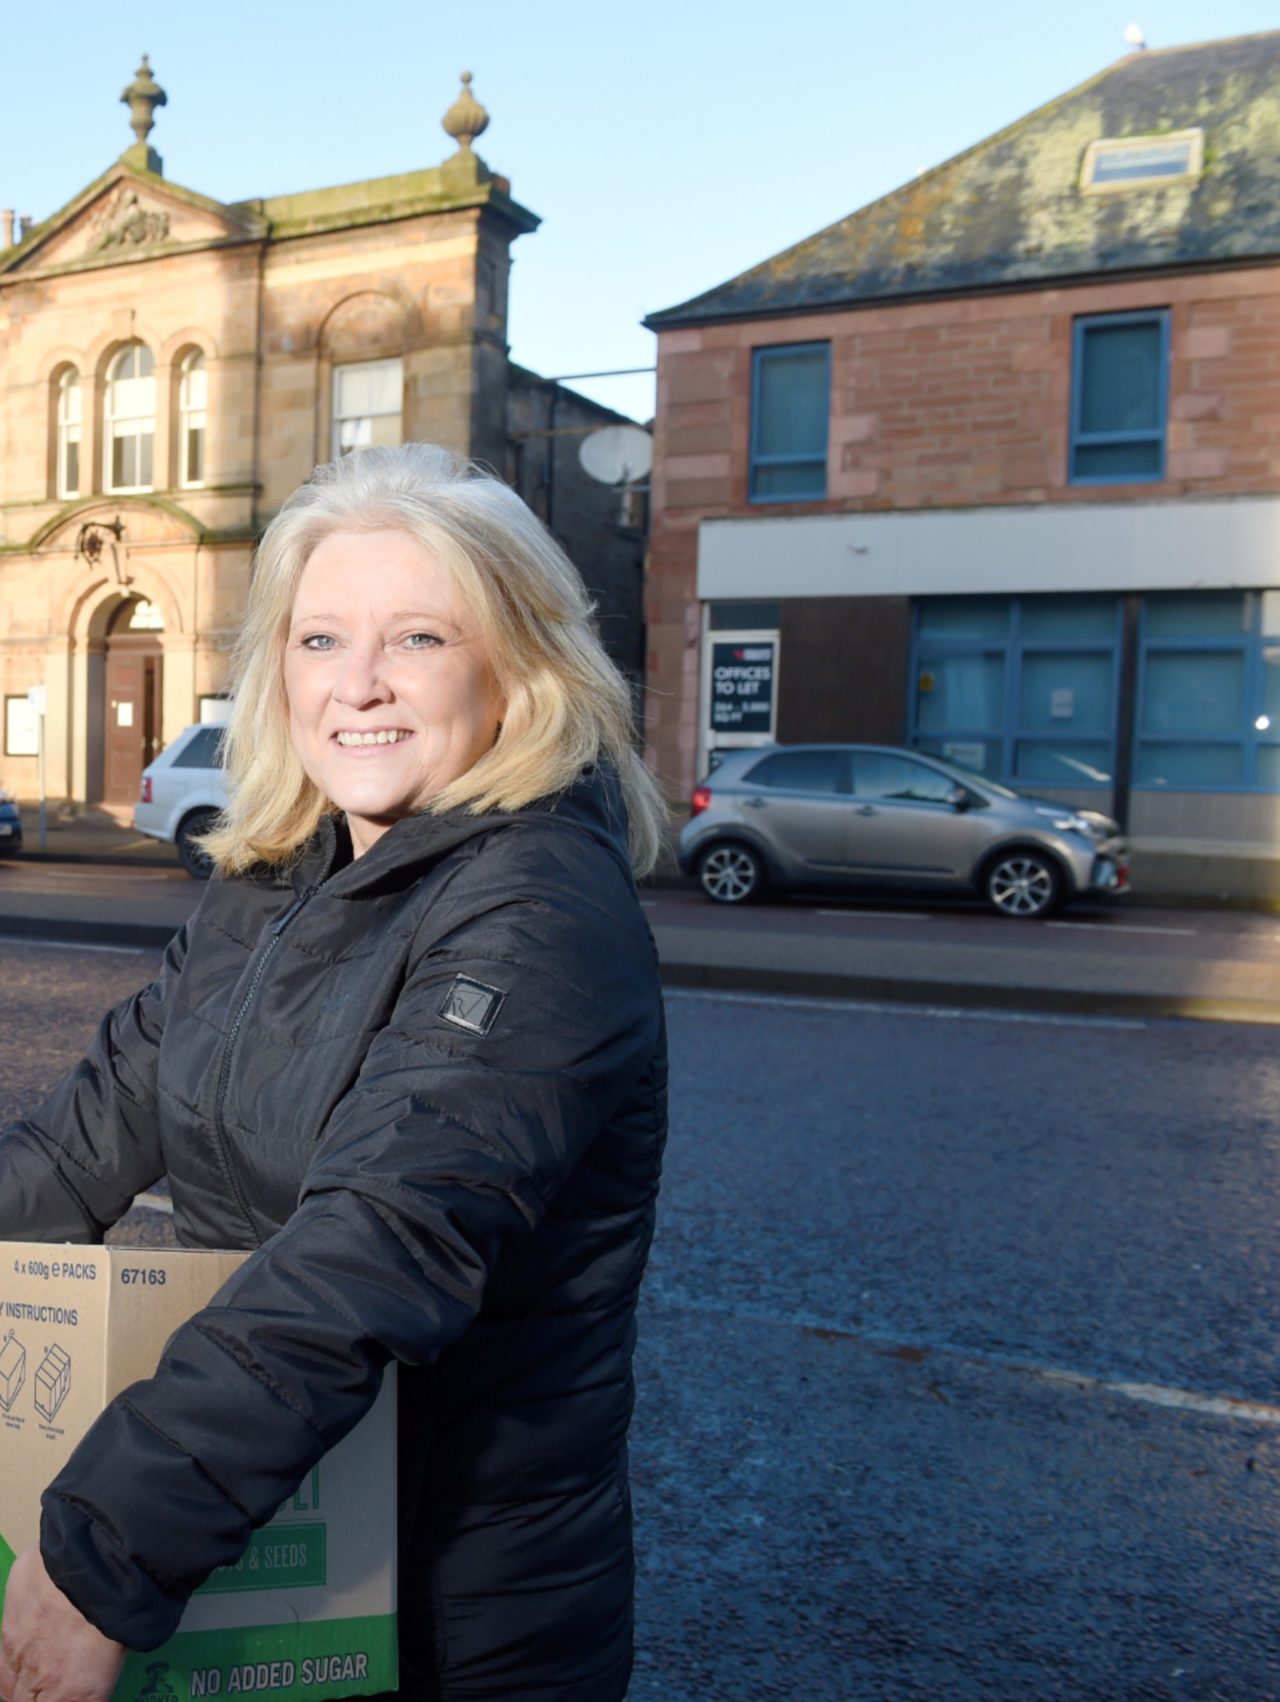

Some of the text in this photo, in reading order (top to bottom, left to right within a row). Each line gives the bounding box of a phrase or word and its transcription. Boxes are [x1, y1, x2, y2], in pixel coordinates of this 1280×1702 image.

[714, 666, 771, 680] OFFICES
[715, 681, 760, 695] TO LET
[14, 1260, 20, 1273] 4
[28, 1261, 49, 1279] 600g
[62, 1263, 96, 1280] PACKS
[121, 1268, 167, 1285] 67163
[6, 1302, 78, 1326] INSTRUCTIONS
[250, 1547, 259, 1569] &
[265, 1544, 307, 1569] SEEDS
[191, 1654, 368, 1697] NO ADDED SUGAR
